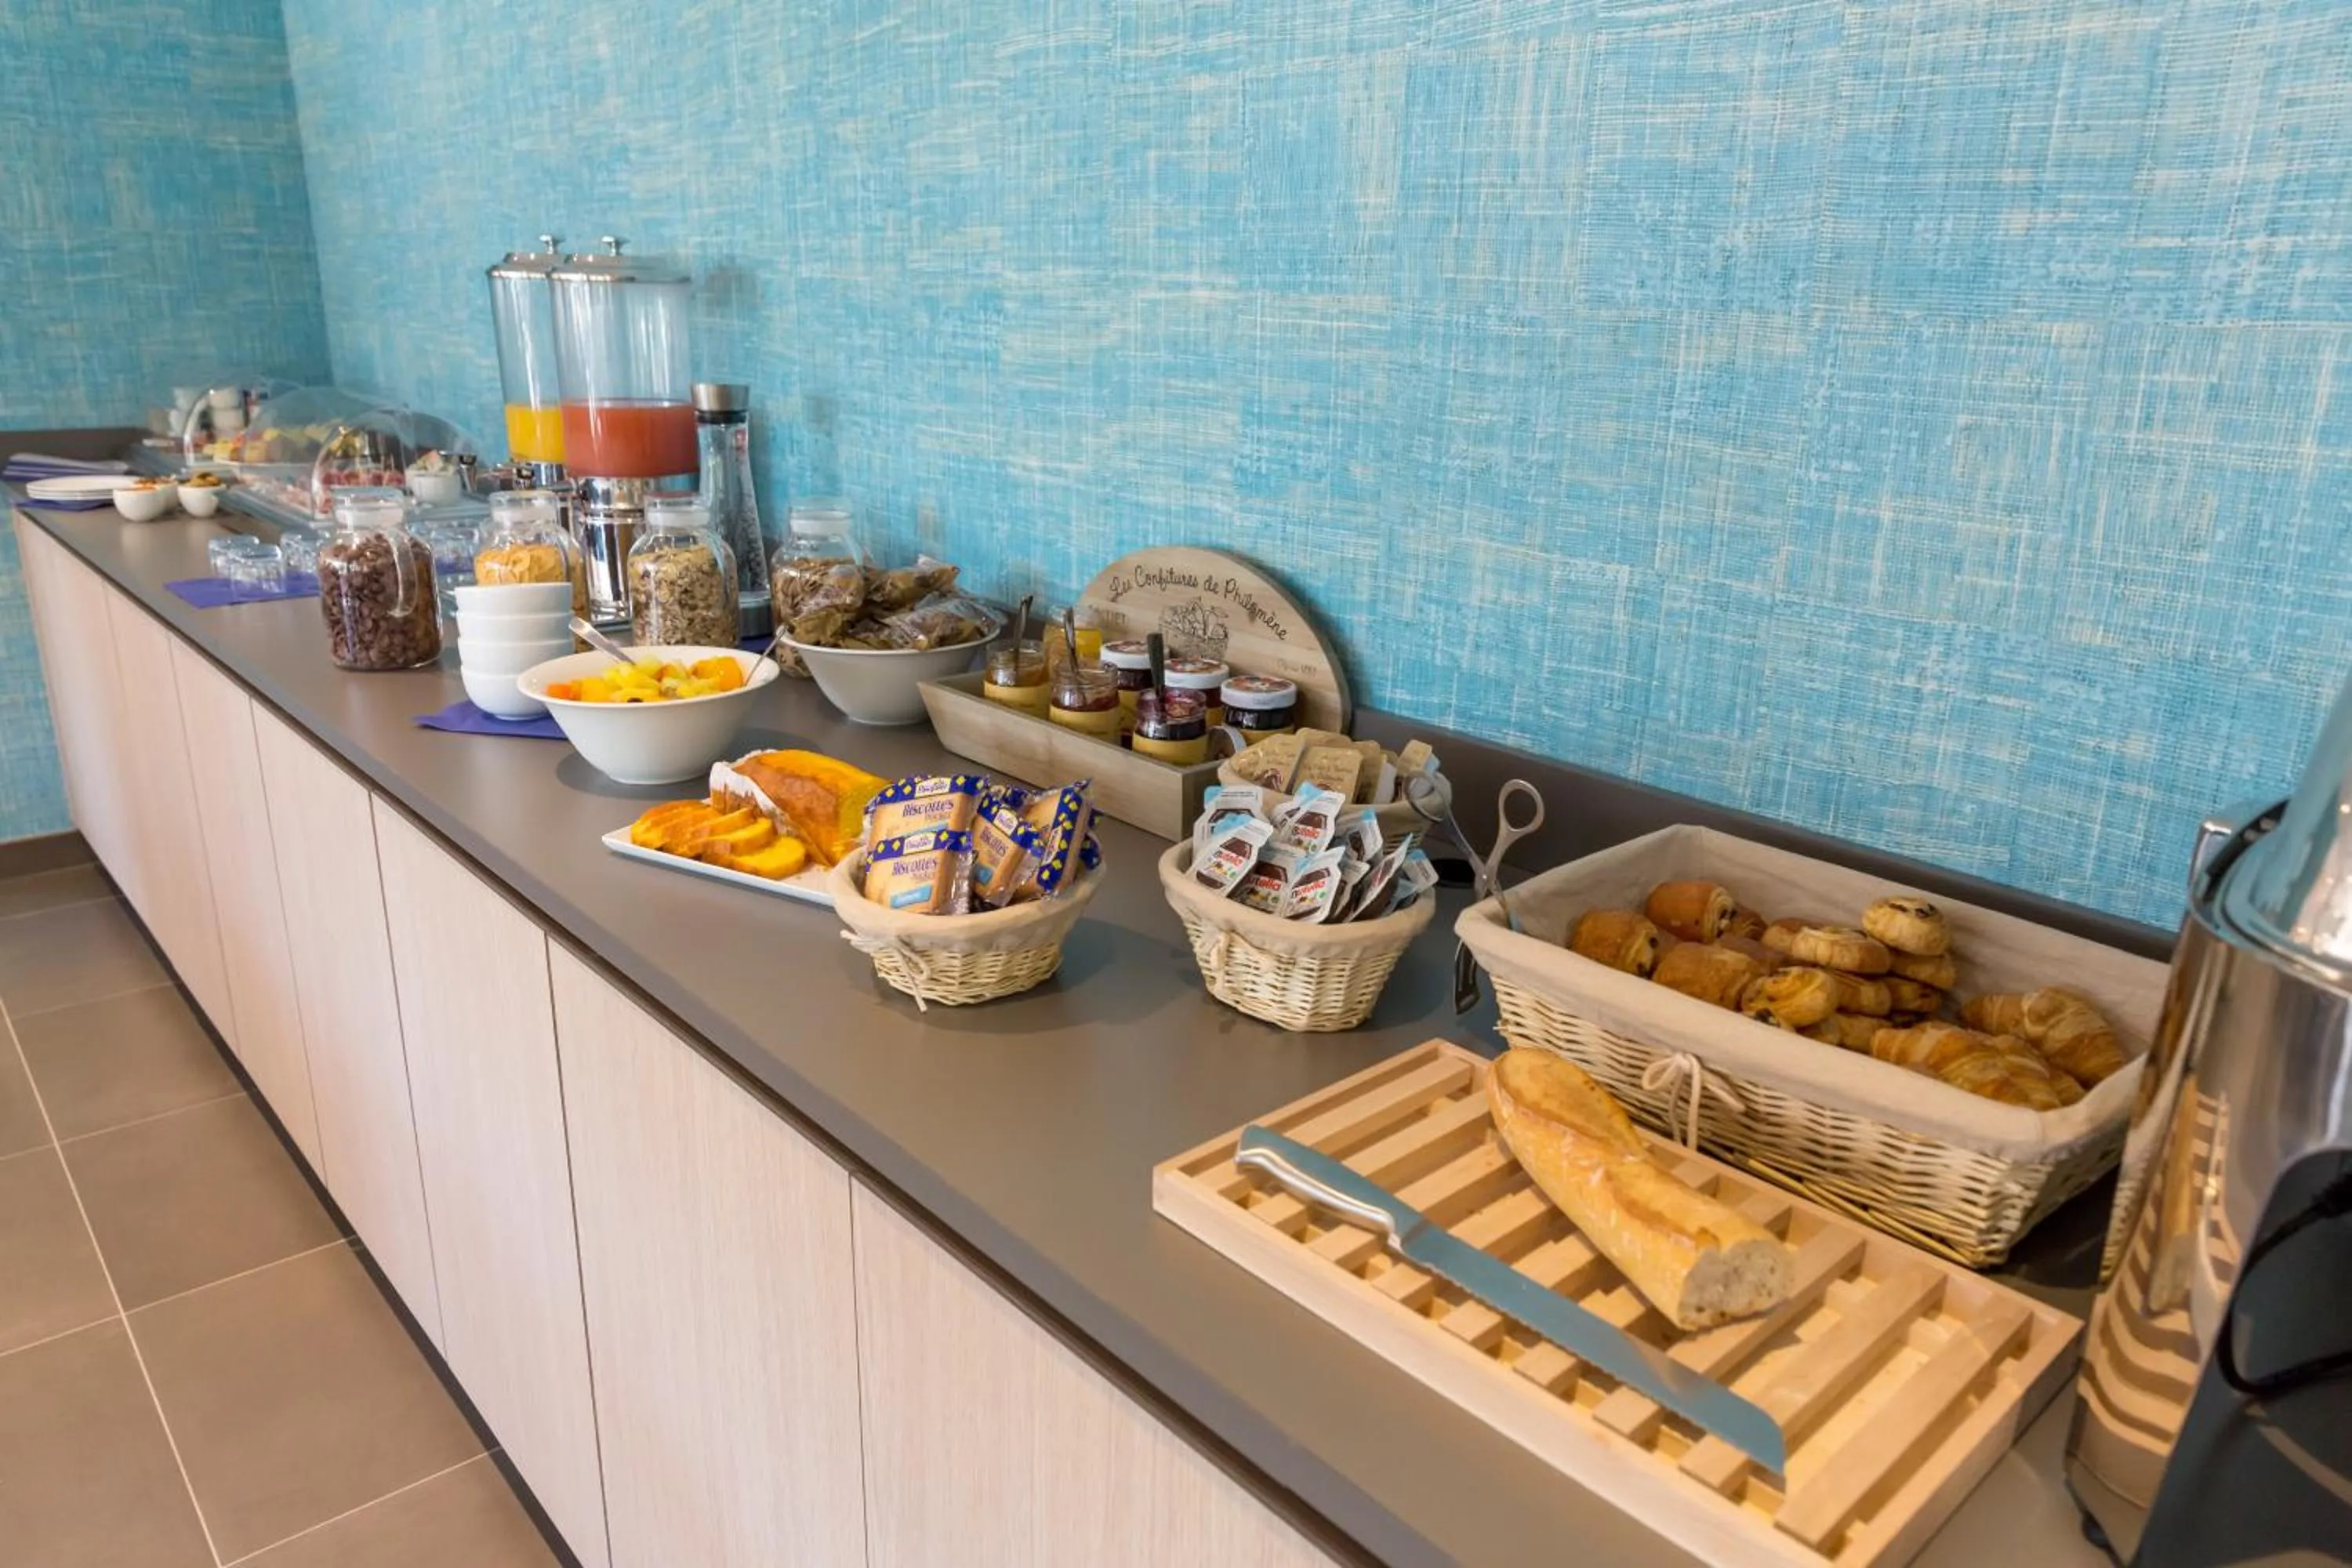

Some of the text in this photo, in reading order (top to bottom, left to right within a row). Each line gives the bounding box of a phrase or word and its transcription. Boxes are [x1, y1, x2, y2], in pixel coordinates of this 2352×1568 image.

[1109, 576, 1133, 597] Les
[1134, 565, 1199, 592] Confitures
[1203, 575, 1219, 595] de
